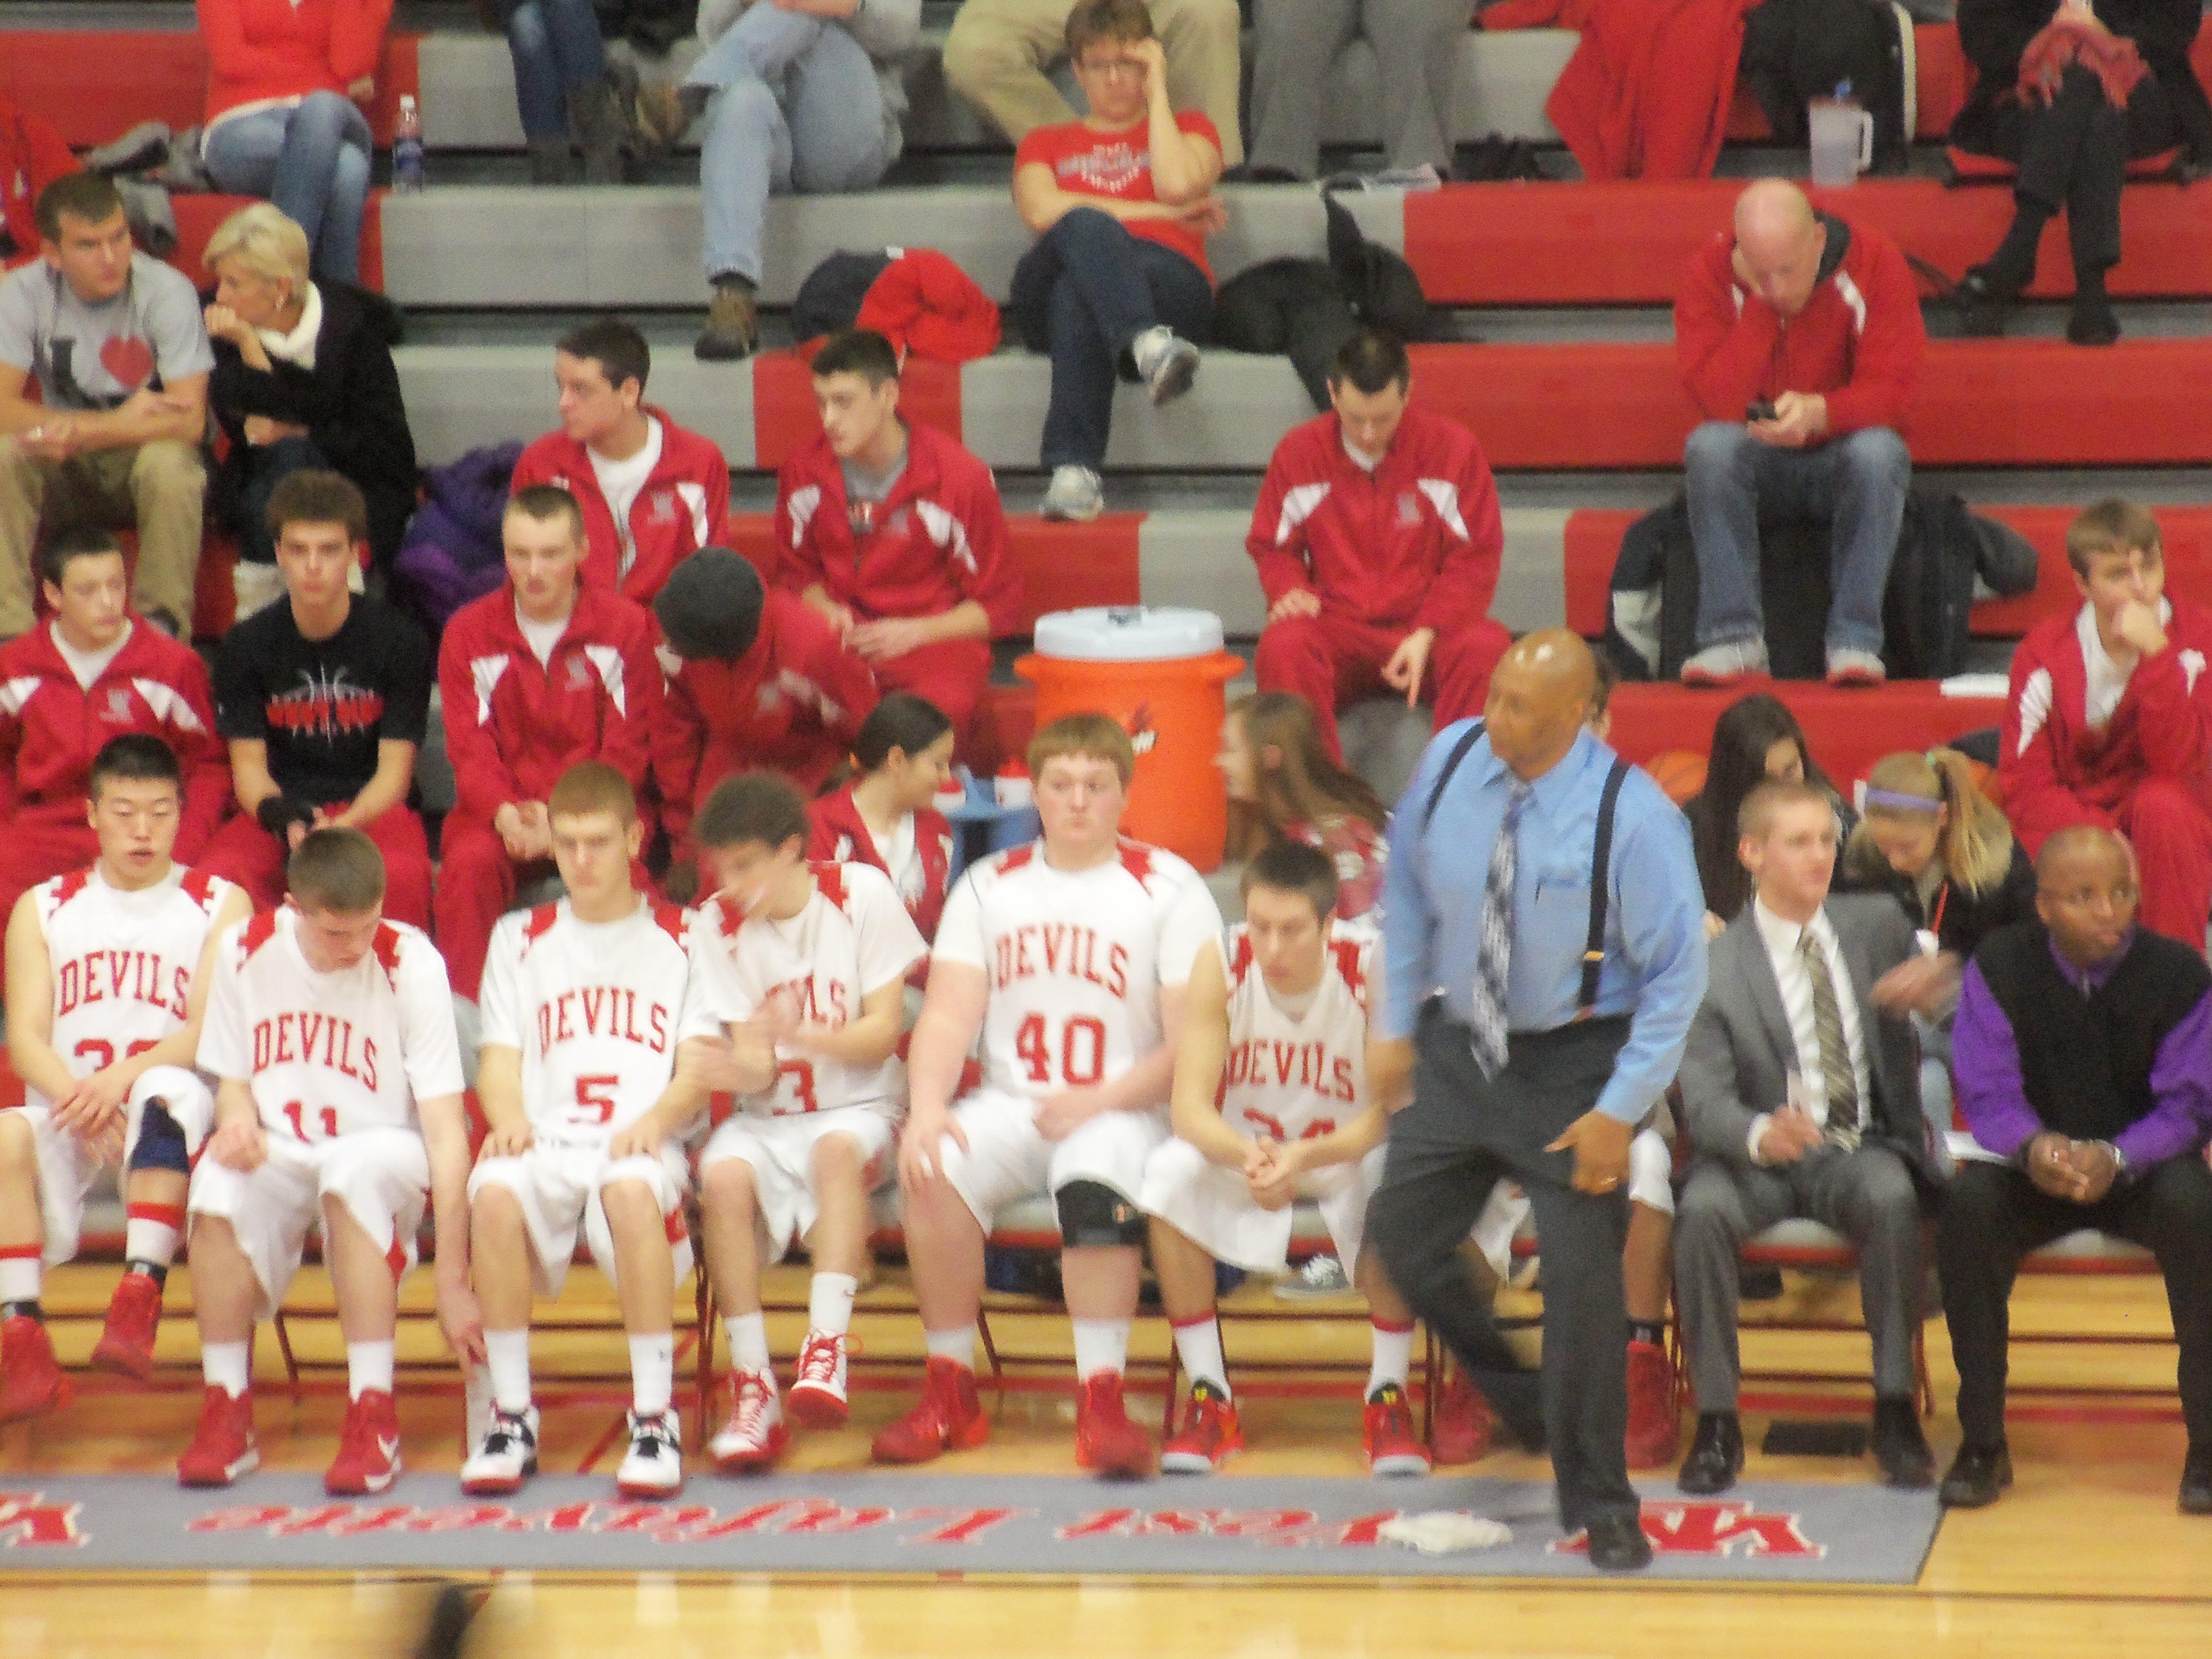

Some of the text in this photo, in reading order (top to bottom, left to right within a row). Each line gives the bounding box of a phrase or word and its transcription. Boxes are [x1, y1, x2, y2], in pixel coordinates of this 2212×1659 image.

[59, 950, 190, 1020] DEVILS
[997, 922, 1128, 1001] DEVILS
[252, 1012, 378, 1092] DEVILS
[538, 985, 667, 1055] DEVILS
[1016, 1012, 1105, 1086] 40
[568, 1075, 618, 1124] 5
[1227, 1039, 1355, 1103] DEVILS
[283, 1100, 337, 1143] 11
